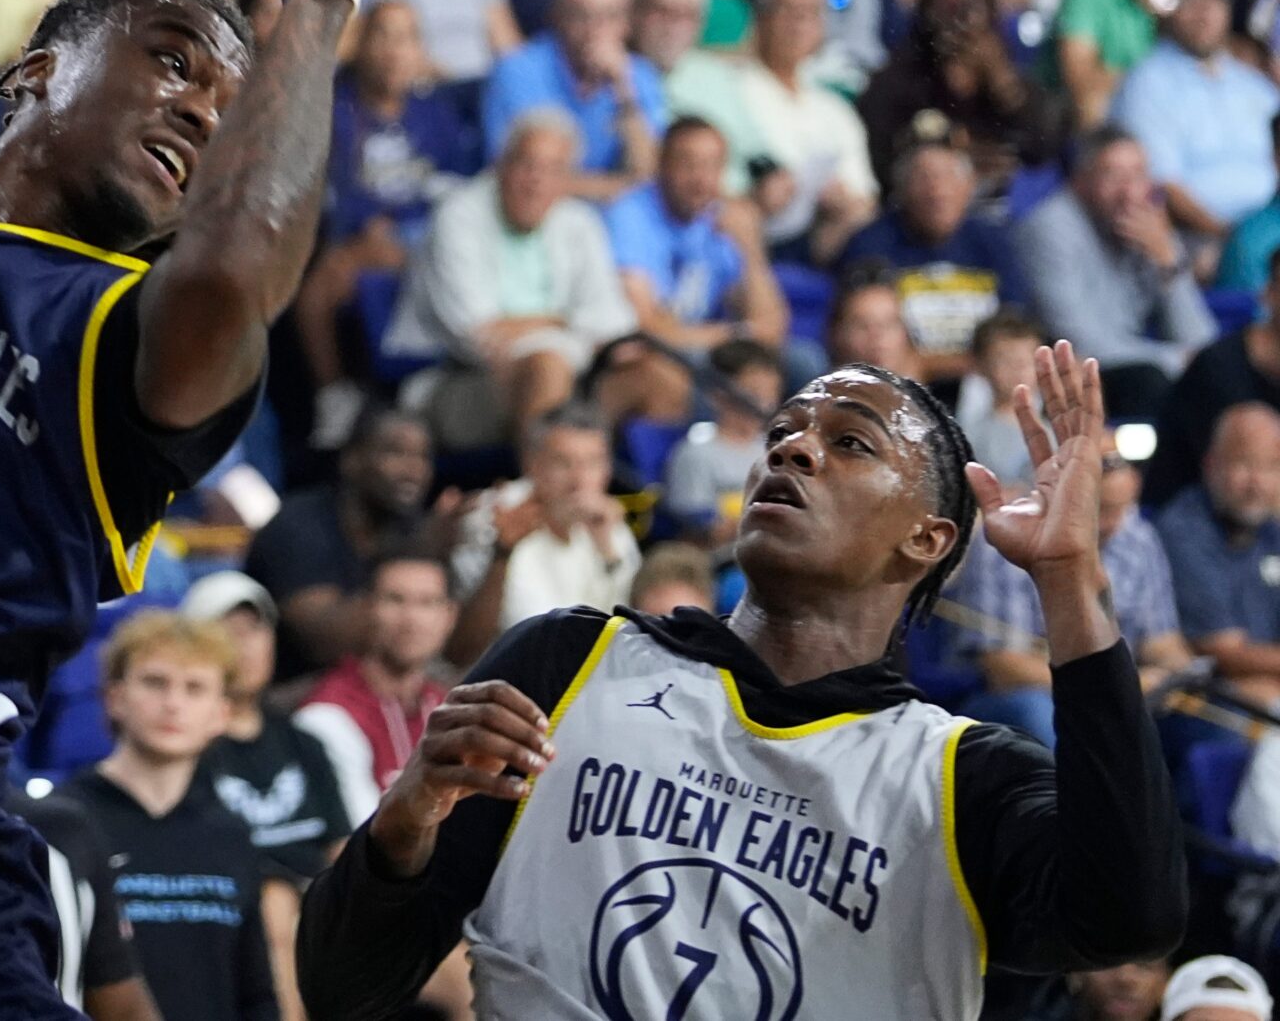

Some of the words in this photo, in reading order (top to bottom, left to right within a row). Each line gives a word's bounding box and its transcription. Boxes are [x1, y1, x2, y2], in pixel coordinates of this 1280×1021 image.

[677, 762, 813, 817] MARQUETTE
[567, 756, 731, 854] GOLDEN
[735, 809, 889, 934] EAGLES
[665, 940, 719, 1021] 7
